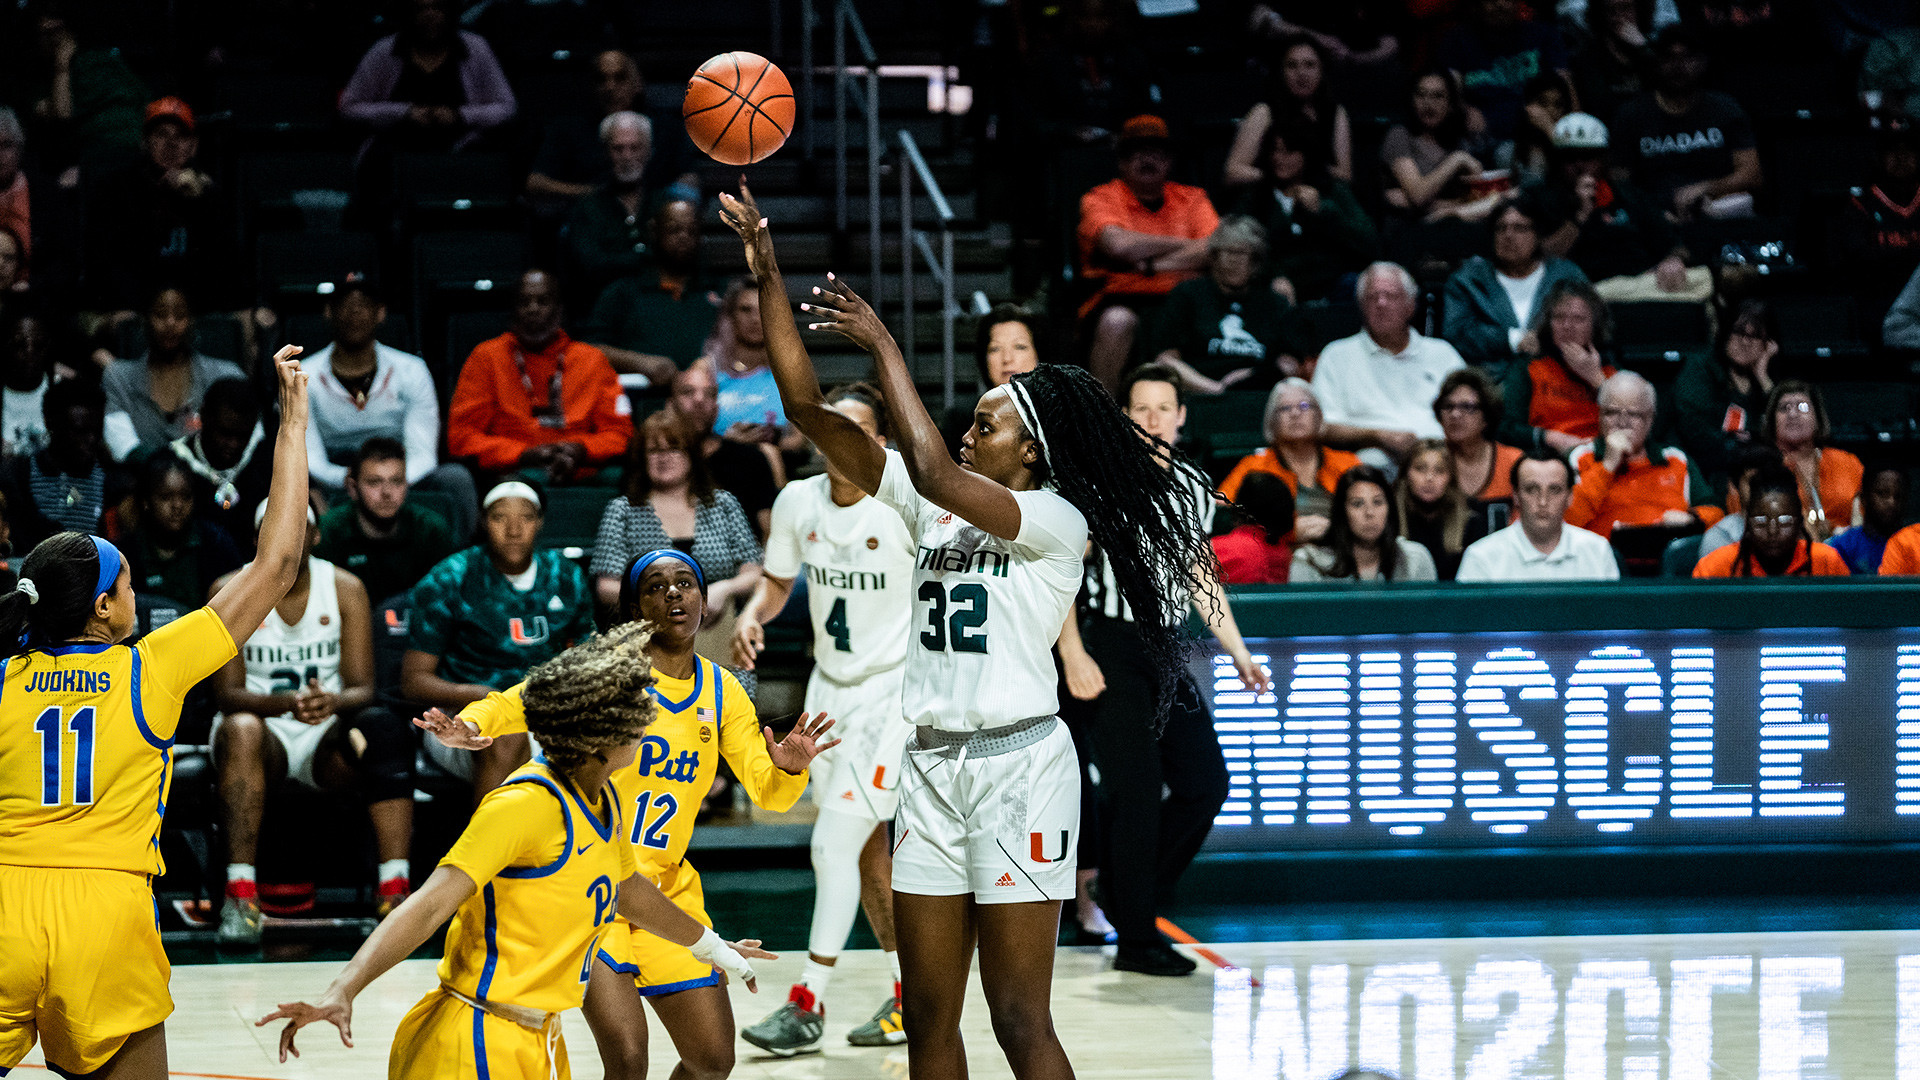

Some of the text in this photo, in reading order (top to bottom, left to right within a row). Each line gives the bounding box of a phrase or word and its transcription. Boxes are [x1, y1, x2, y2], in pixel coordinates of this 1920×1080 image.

[509, 615, 549, 646] U
[825, 596, 852, 653] 4
[918, 581, 988, 654] 32
[24, 669, 111, 693] JUDKINS
[33, 705, 97, 806] 11
[638, 735, 700, 784] Pitt
[1213, 645, 1847, 834] MUSCLE
[630, 790, 679, 850] 12
[1030, 830, 1068, 863] U
